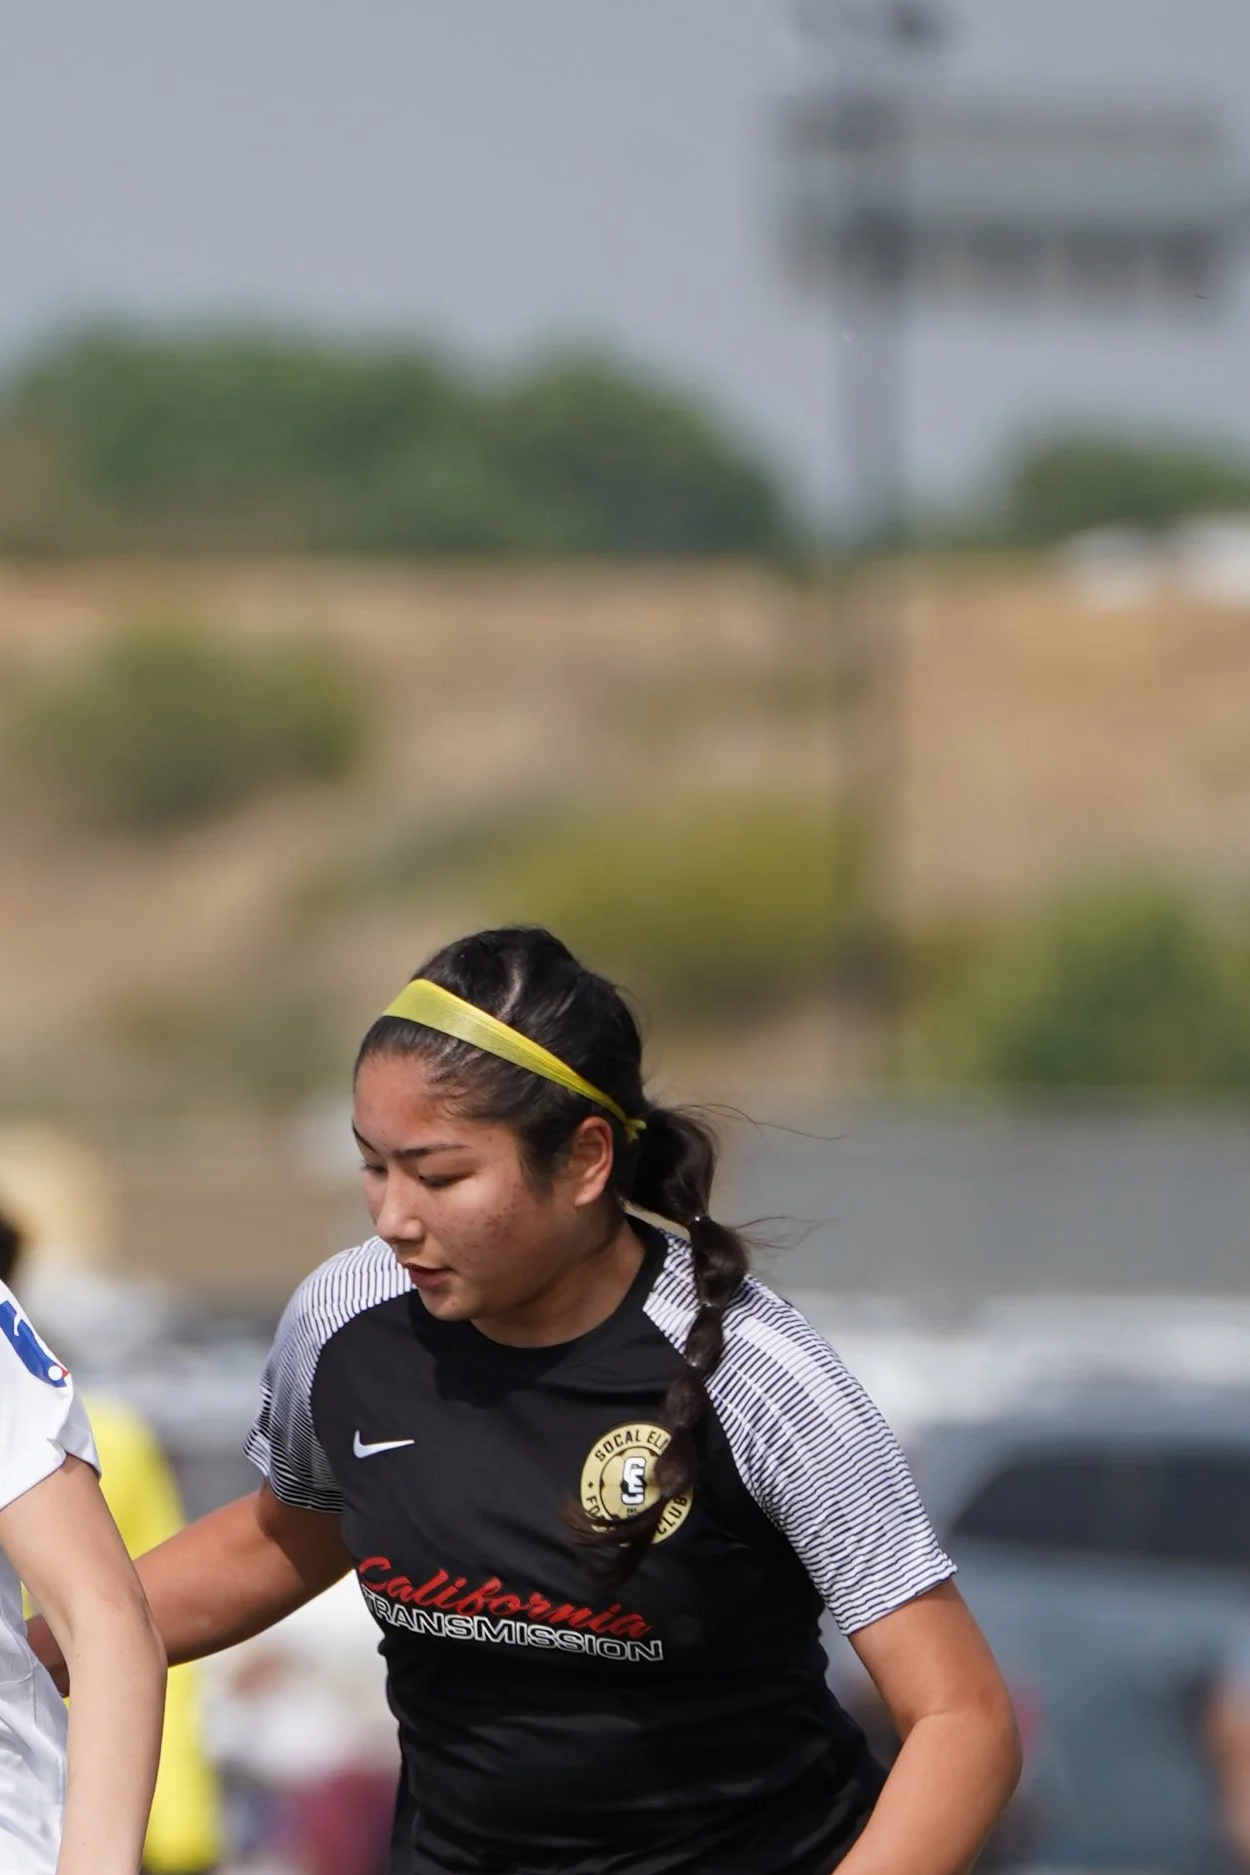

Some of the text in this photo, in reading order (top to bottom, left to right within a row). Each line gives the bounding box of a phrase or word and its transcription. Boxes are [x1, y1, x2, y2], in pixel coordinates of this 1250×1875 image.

[595, 1429, 669, 1462] SOCAL ELI
[657, 1495, 688, 1535] CLUB
[358, 1555, 653, 1640] California
